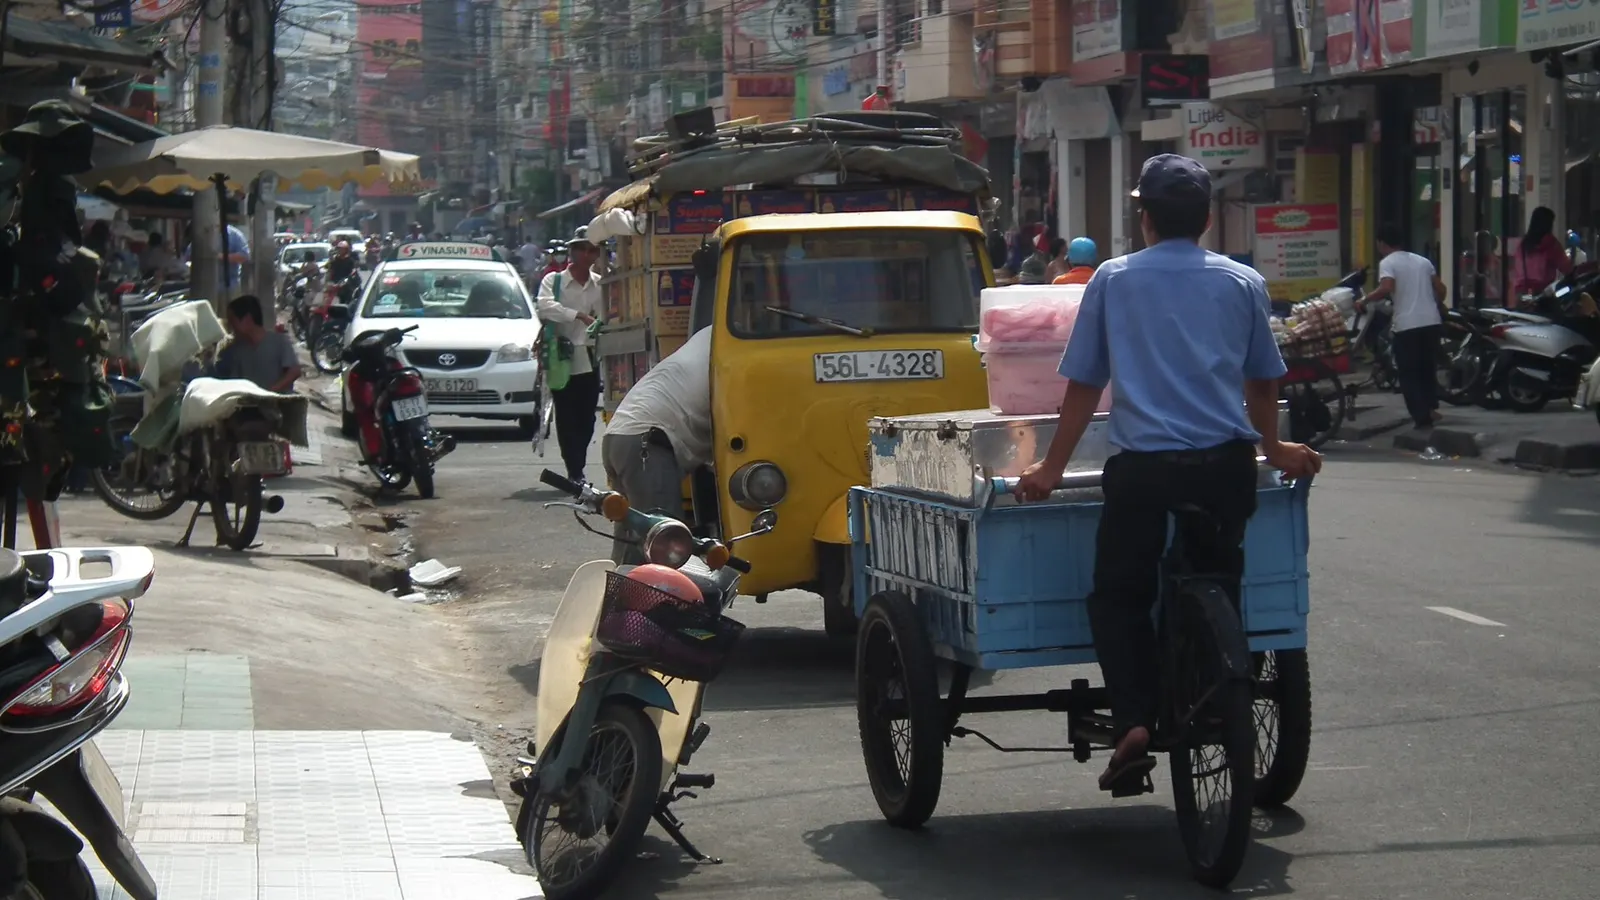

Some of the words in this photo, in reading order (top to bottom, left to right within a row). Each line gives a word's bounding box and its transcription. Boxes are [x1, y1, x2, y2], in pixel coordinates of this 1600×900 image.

[100, 11, 123, 21] VISA
[1188, 108, 1226, 124] Little
[1189, 126, 1259, 147] India
[420, 246, 467, 256] VINASUN
[468, 246, 490, 257] TAXI
[445, 378, 475, 391] 6120
